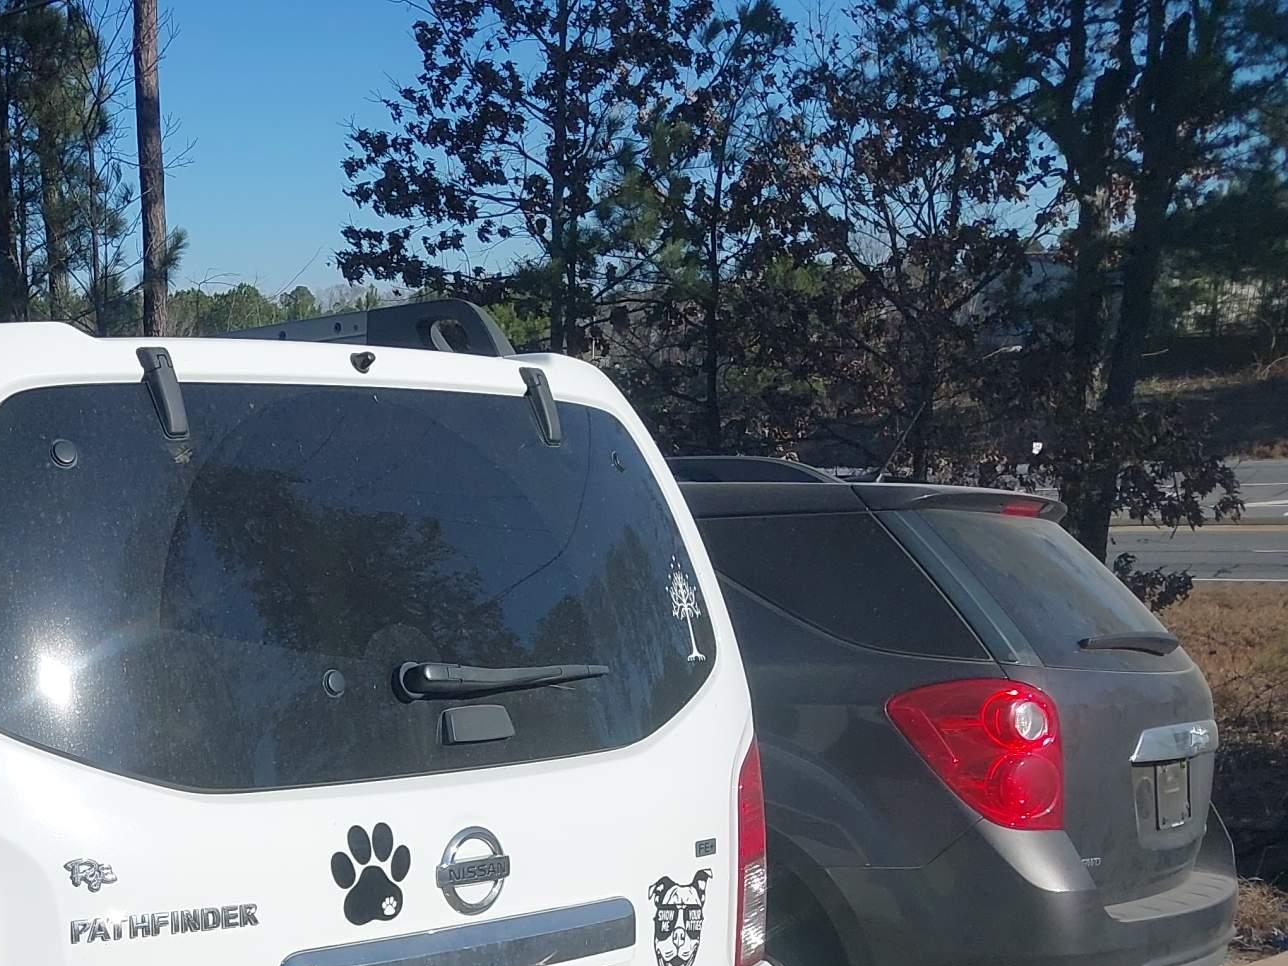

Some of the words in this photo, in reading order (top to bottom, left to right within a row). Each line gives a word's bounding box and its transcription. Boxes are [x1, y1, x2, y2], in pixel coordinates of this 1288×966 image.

[447, 861, 507, 881] NISSAN
[658, 909, 675, 921] SHOW
[69, 902, 260, 945] PATHFINDER
[661, 920, 672, 932] ME
